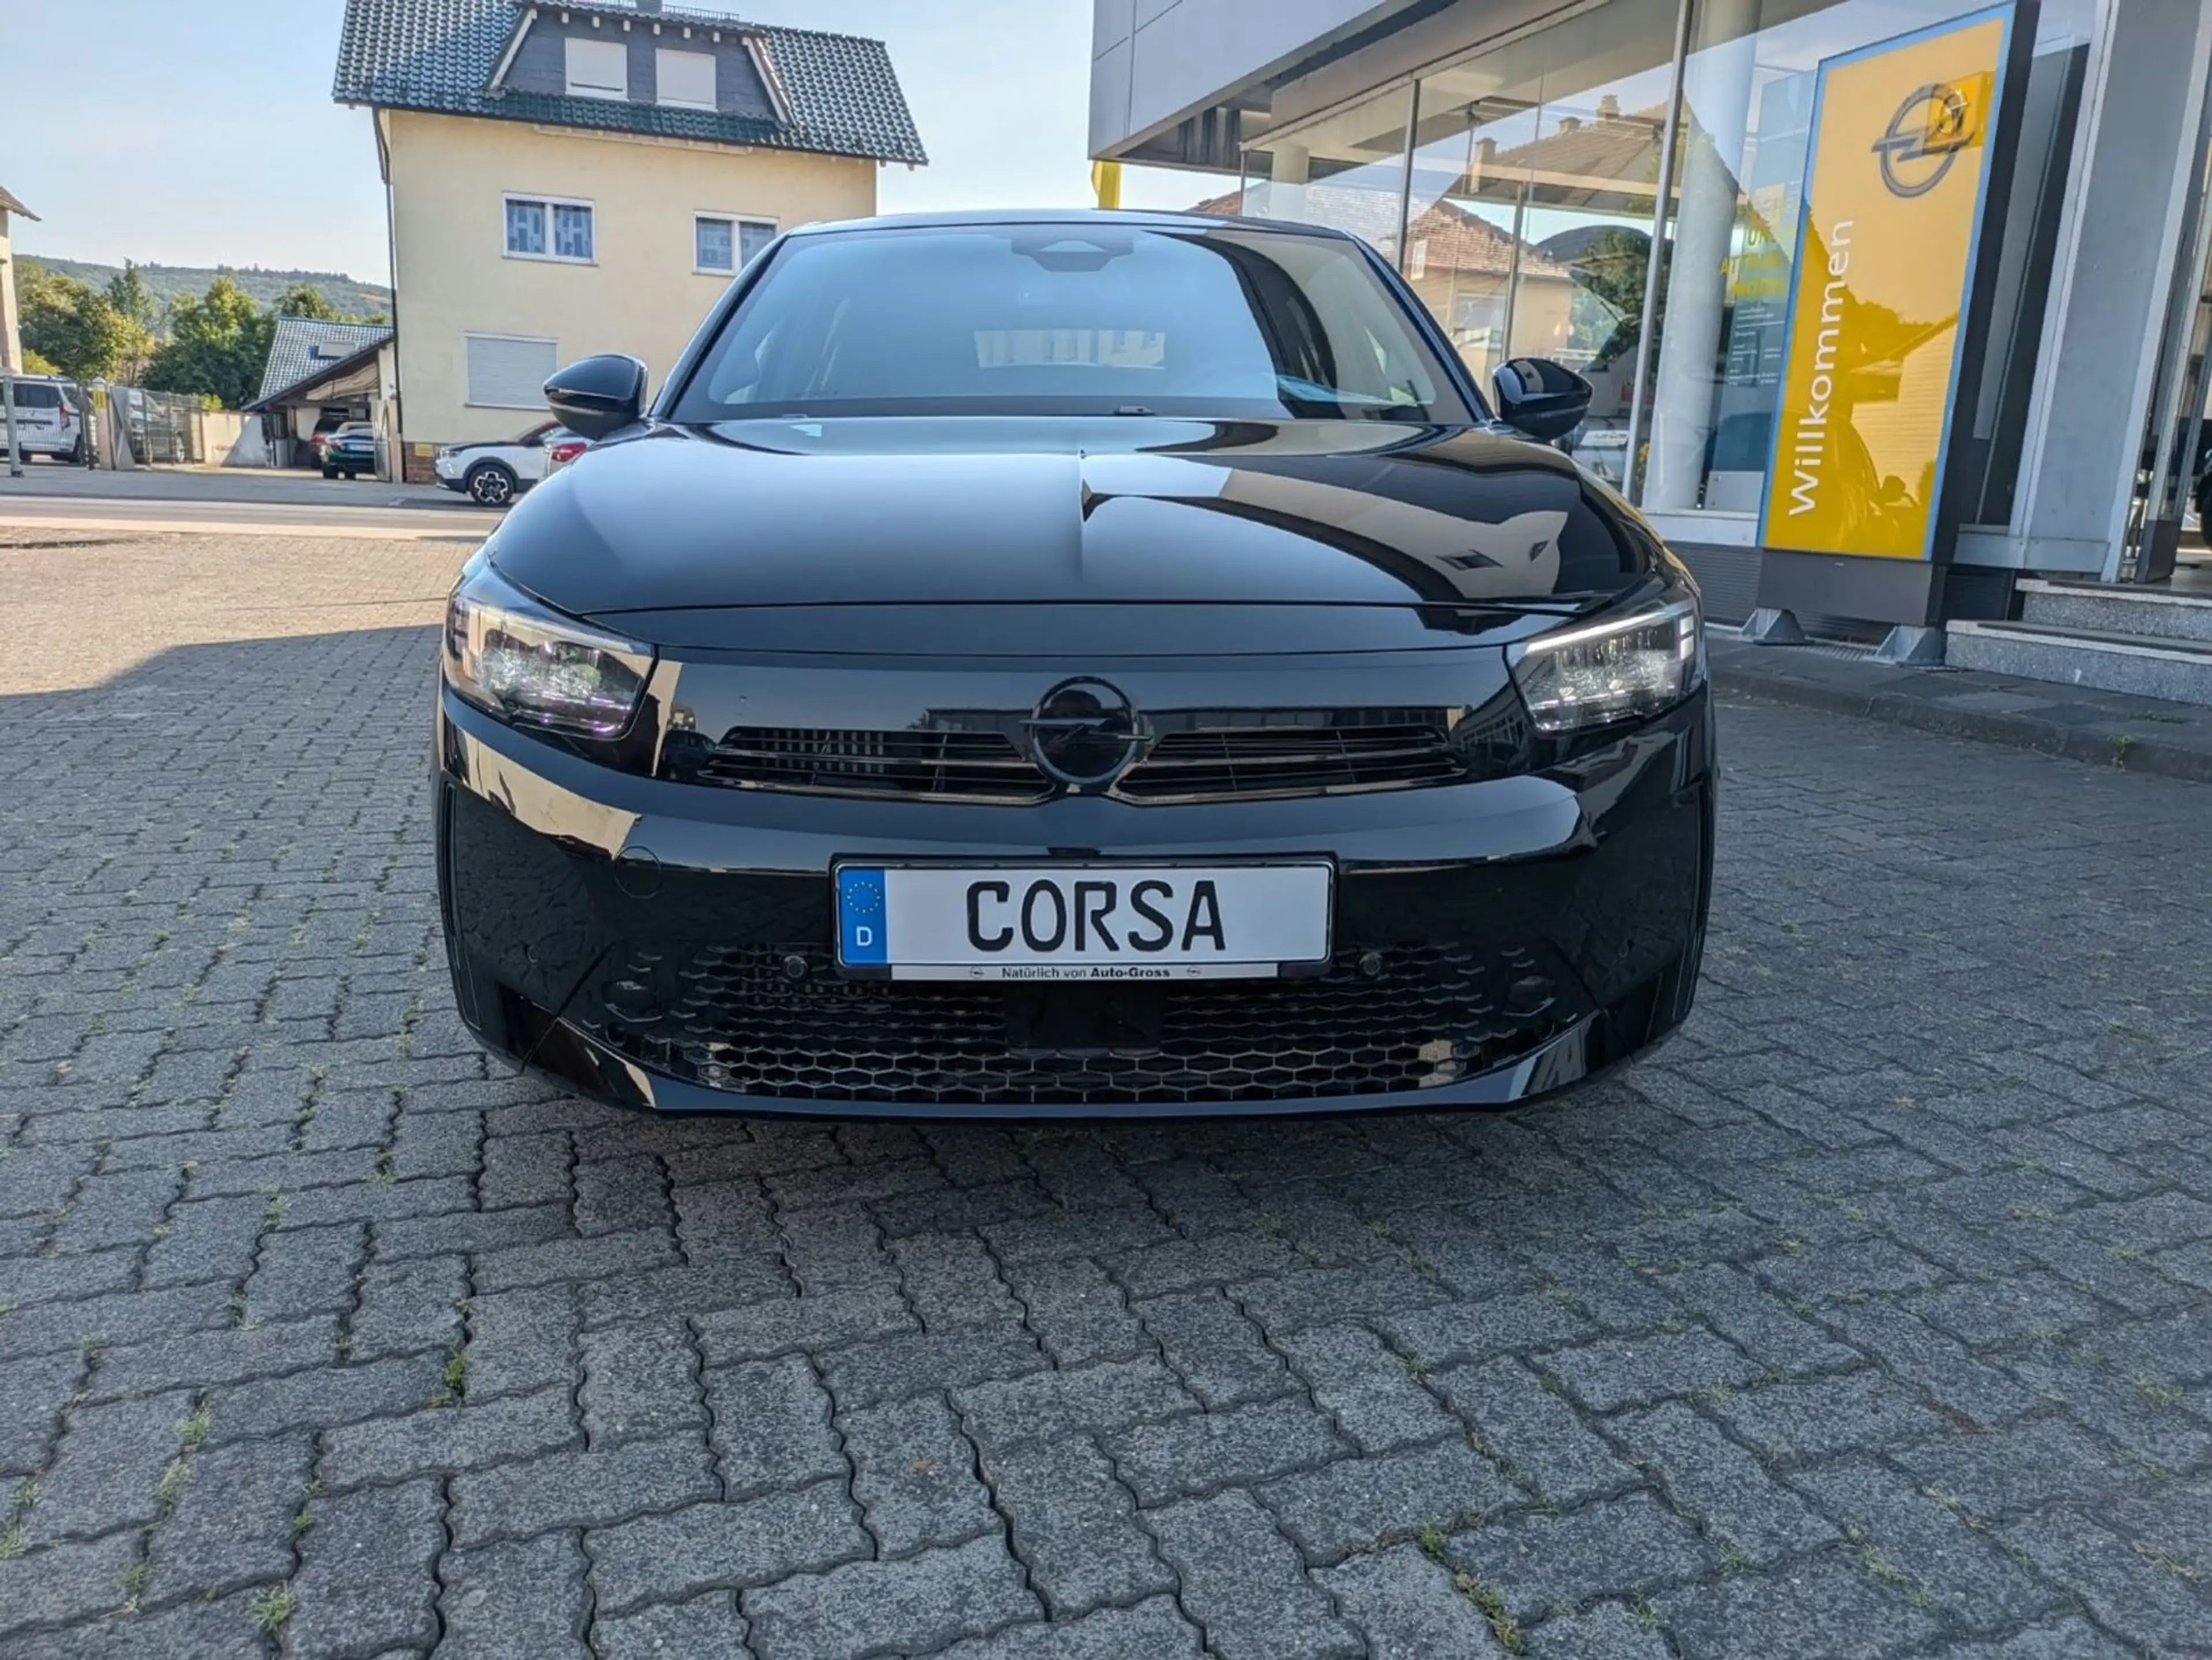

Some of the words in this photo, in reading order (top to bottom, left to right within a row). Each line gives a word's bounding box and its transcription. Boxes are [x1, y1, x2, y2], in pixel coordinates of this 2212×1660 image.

[1789, 220, 1854, 516] Willkommen
[857, 927, 873, 946] D
[967, 879, 1226, 952] CORSA
[1002, 967, 1060, 978] Natürlich
[1064, 969, 1087, 978] von
[1091, 967, 1170, 978] Auto-Gross
